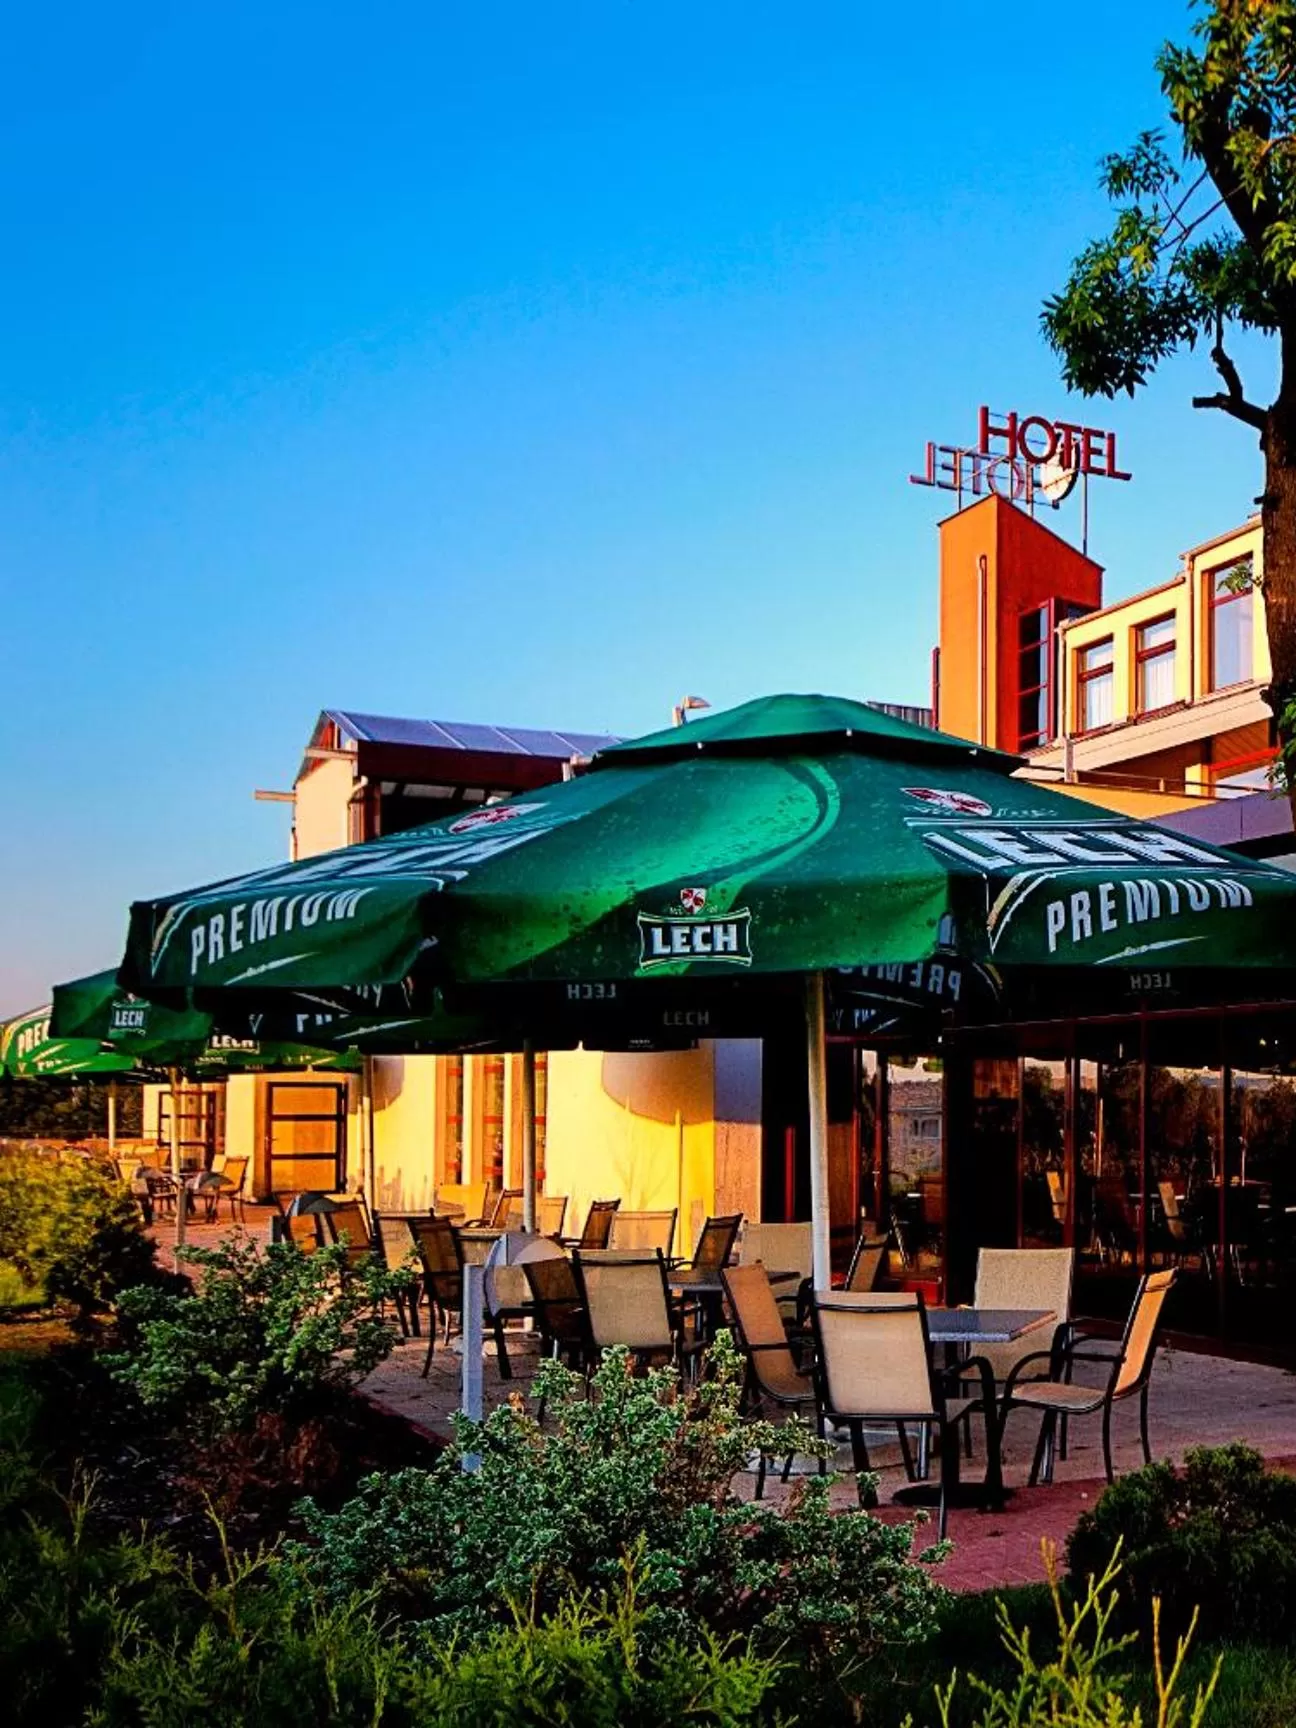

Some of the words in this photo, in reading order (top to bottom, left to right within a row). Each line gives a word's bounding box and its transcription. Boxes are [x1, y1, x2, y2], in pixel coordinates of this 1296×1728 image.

[978, 406, 1132, 481] HOTEL
[921, 829, 1230, 871] LECH
[191, 886, 378, 975] PREMIUM
[651, 924, 738, 955] LECH
[1046, 878, 1253, 952] PREMIUM
[115, 1010, 144, 1027] LECH
